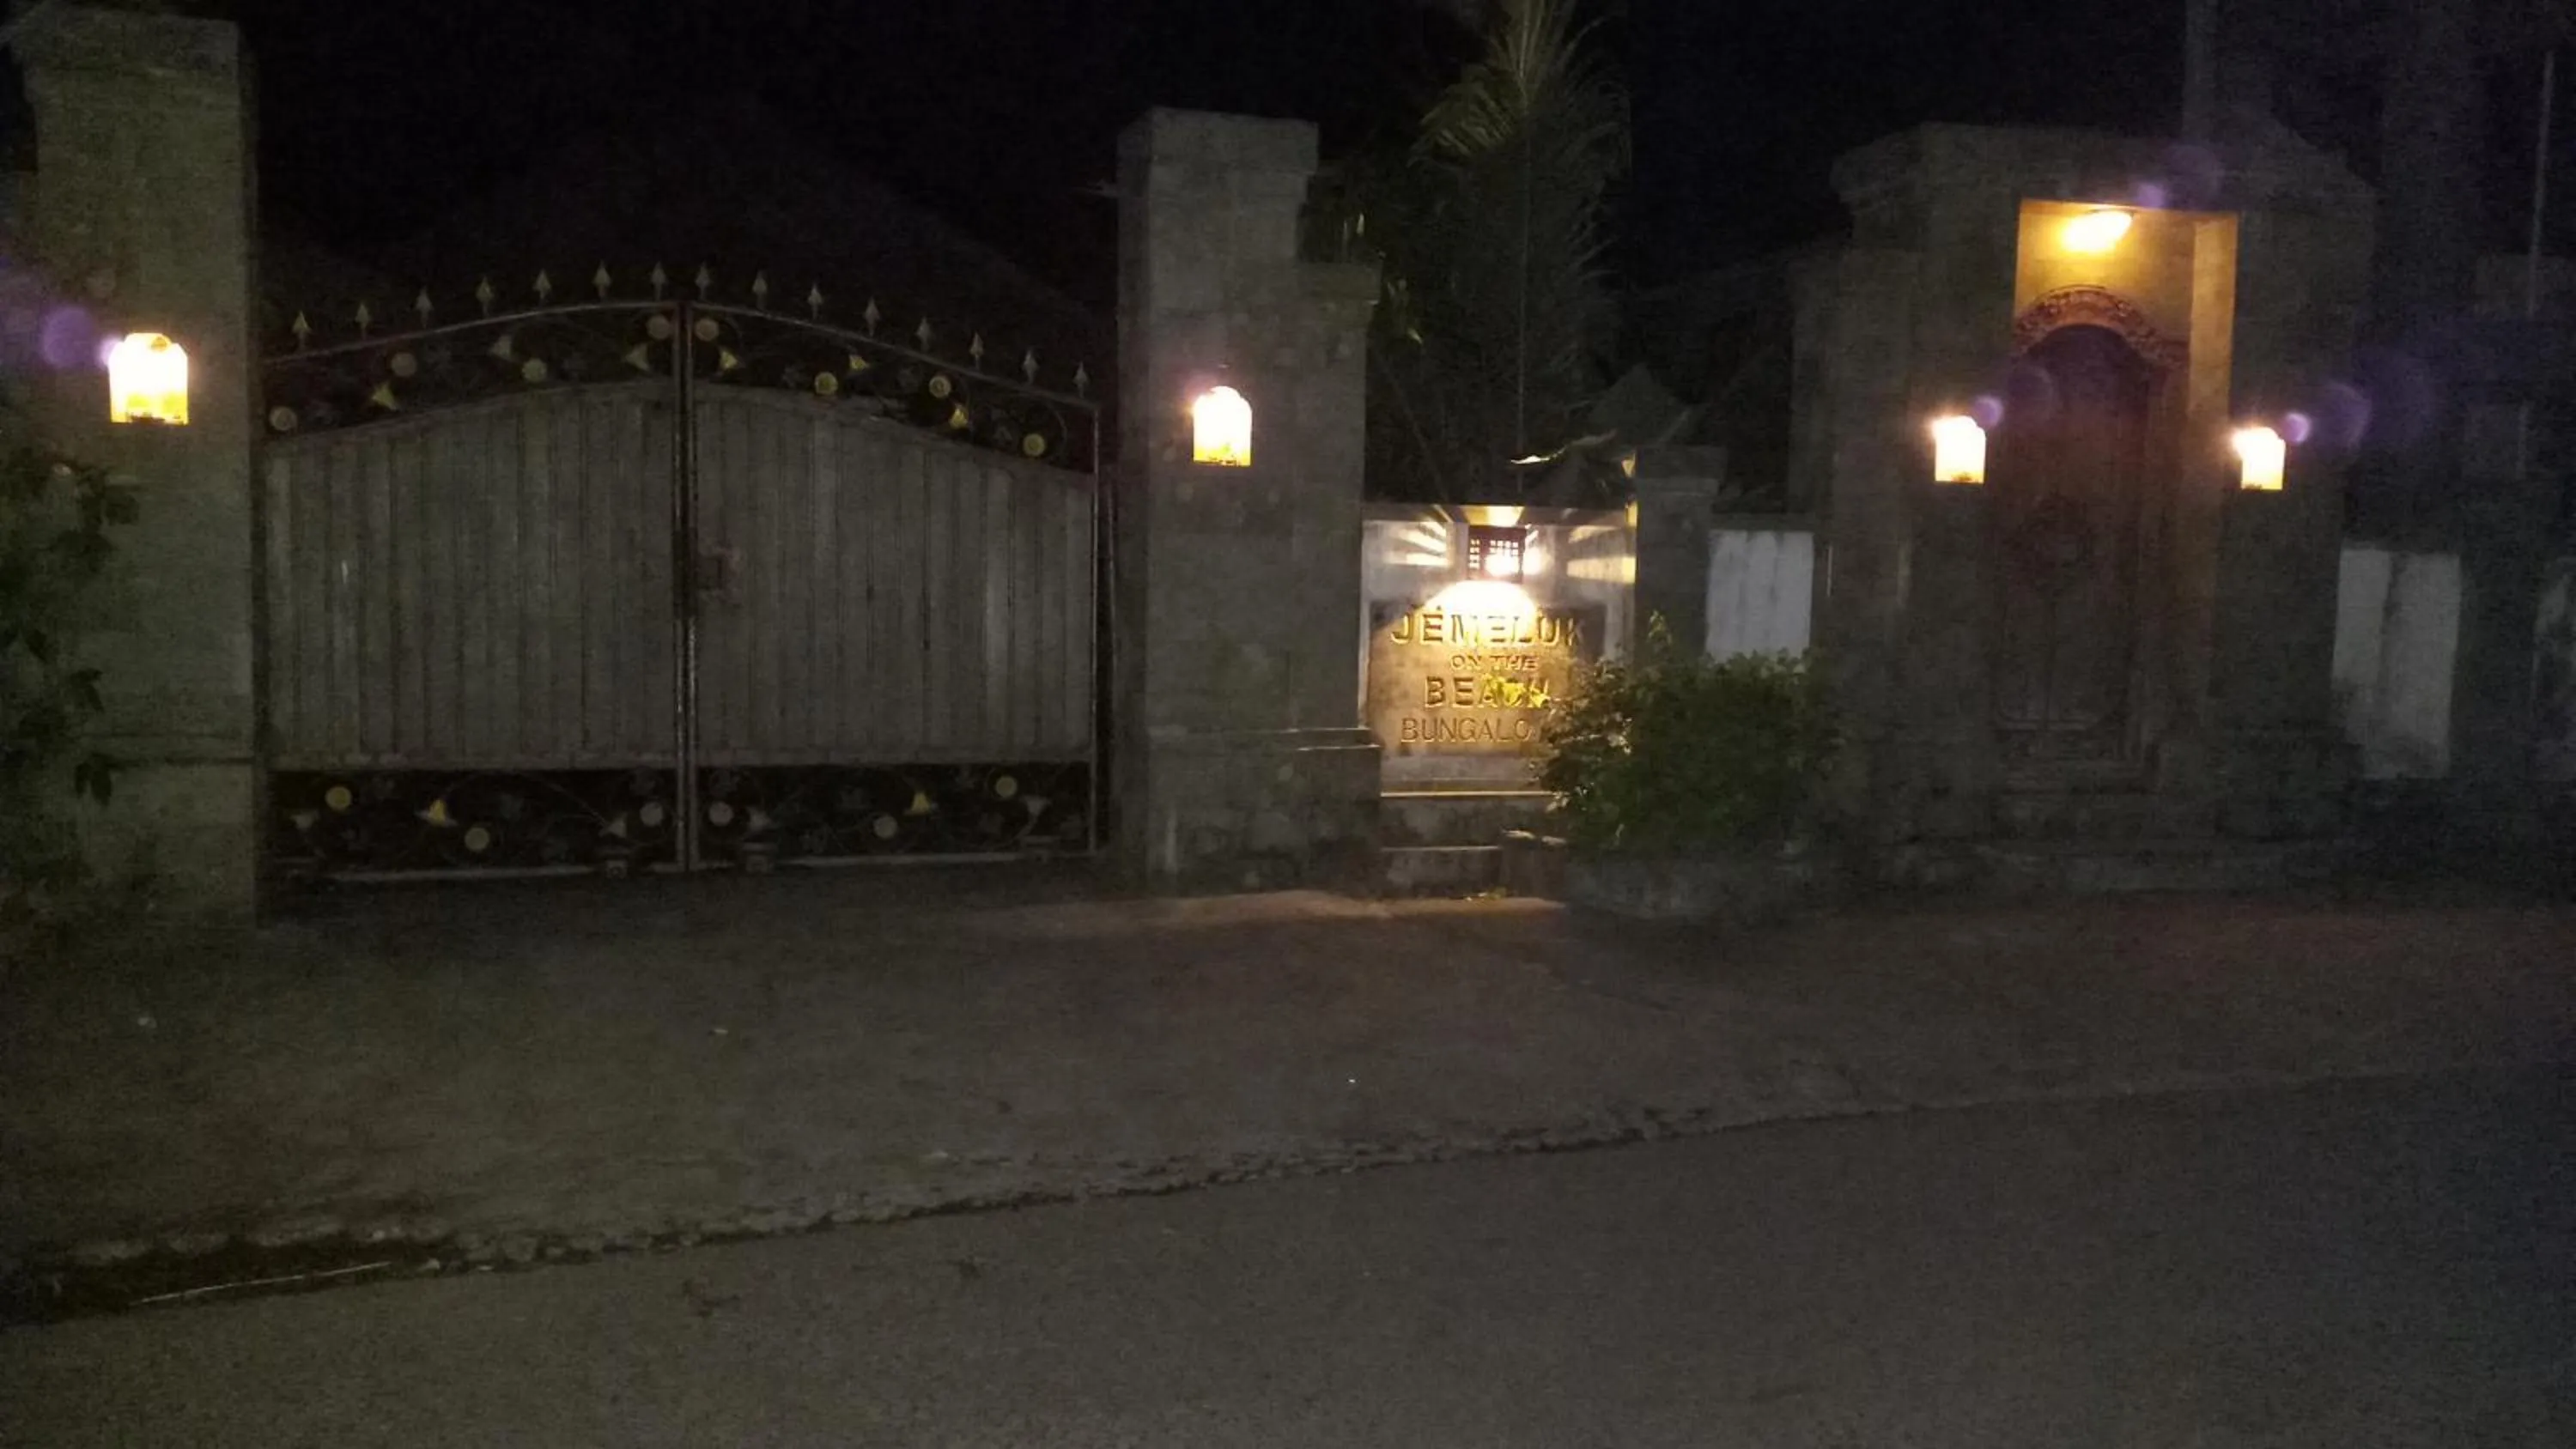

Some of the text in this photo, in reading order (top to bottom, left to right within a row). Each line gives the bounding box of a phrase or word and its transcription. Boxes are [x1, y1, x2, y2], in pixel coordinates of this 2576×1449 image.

[1451, 653, 1540, 670] ON THE
[1400, 716, 1537, 743] BUNGALO
